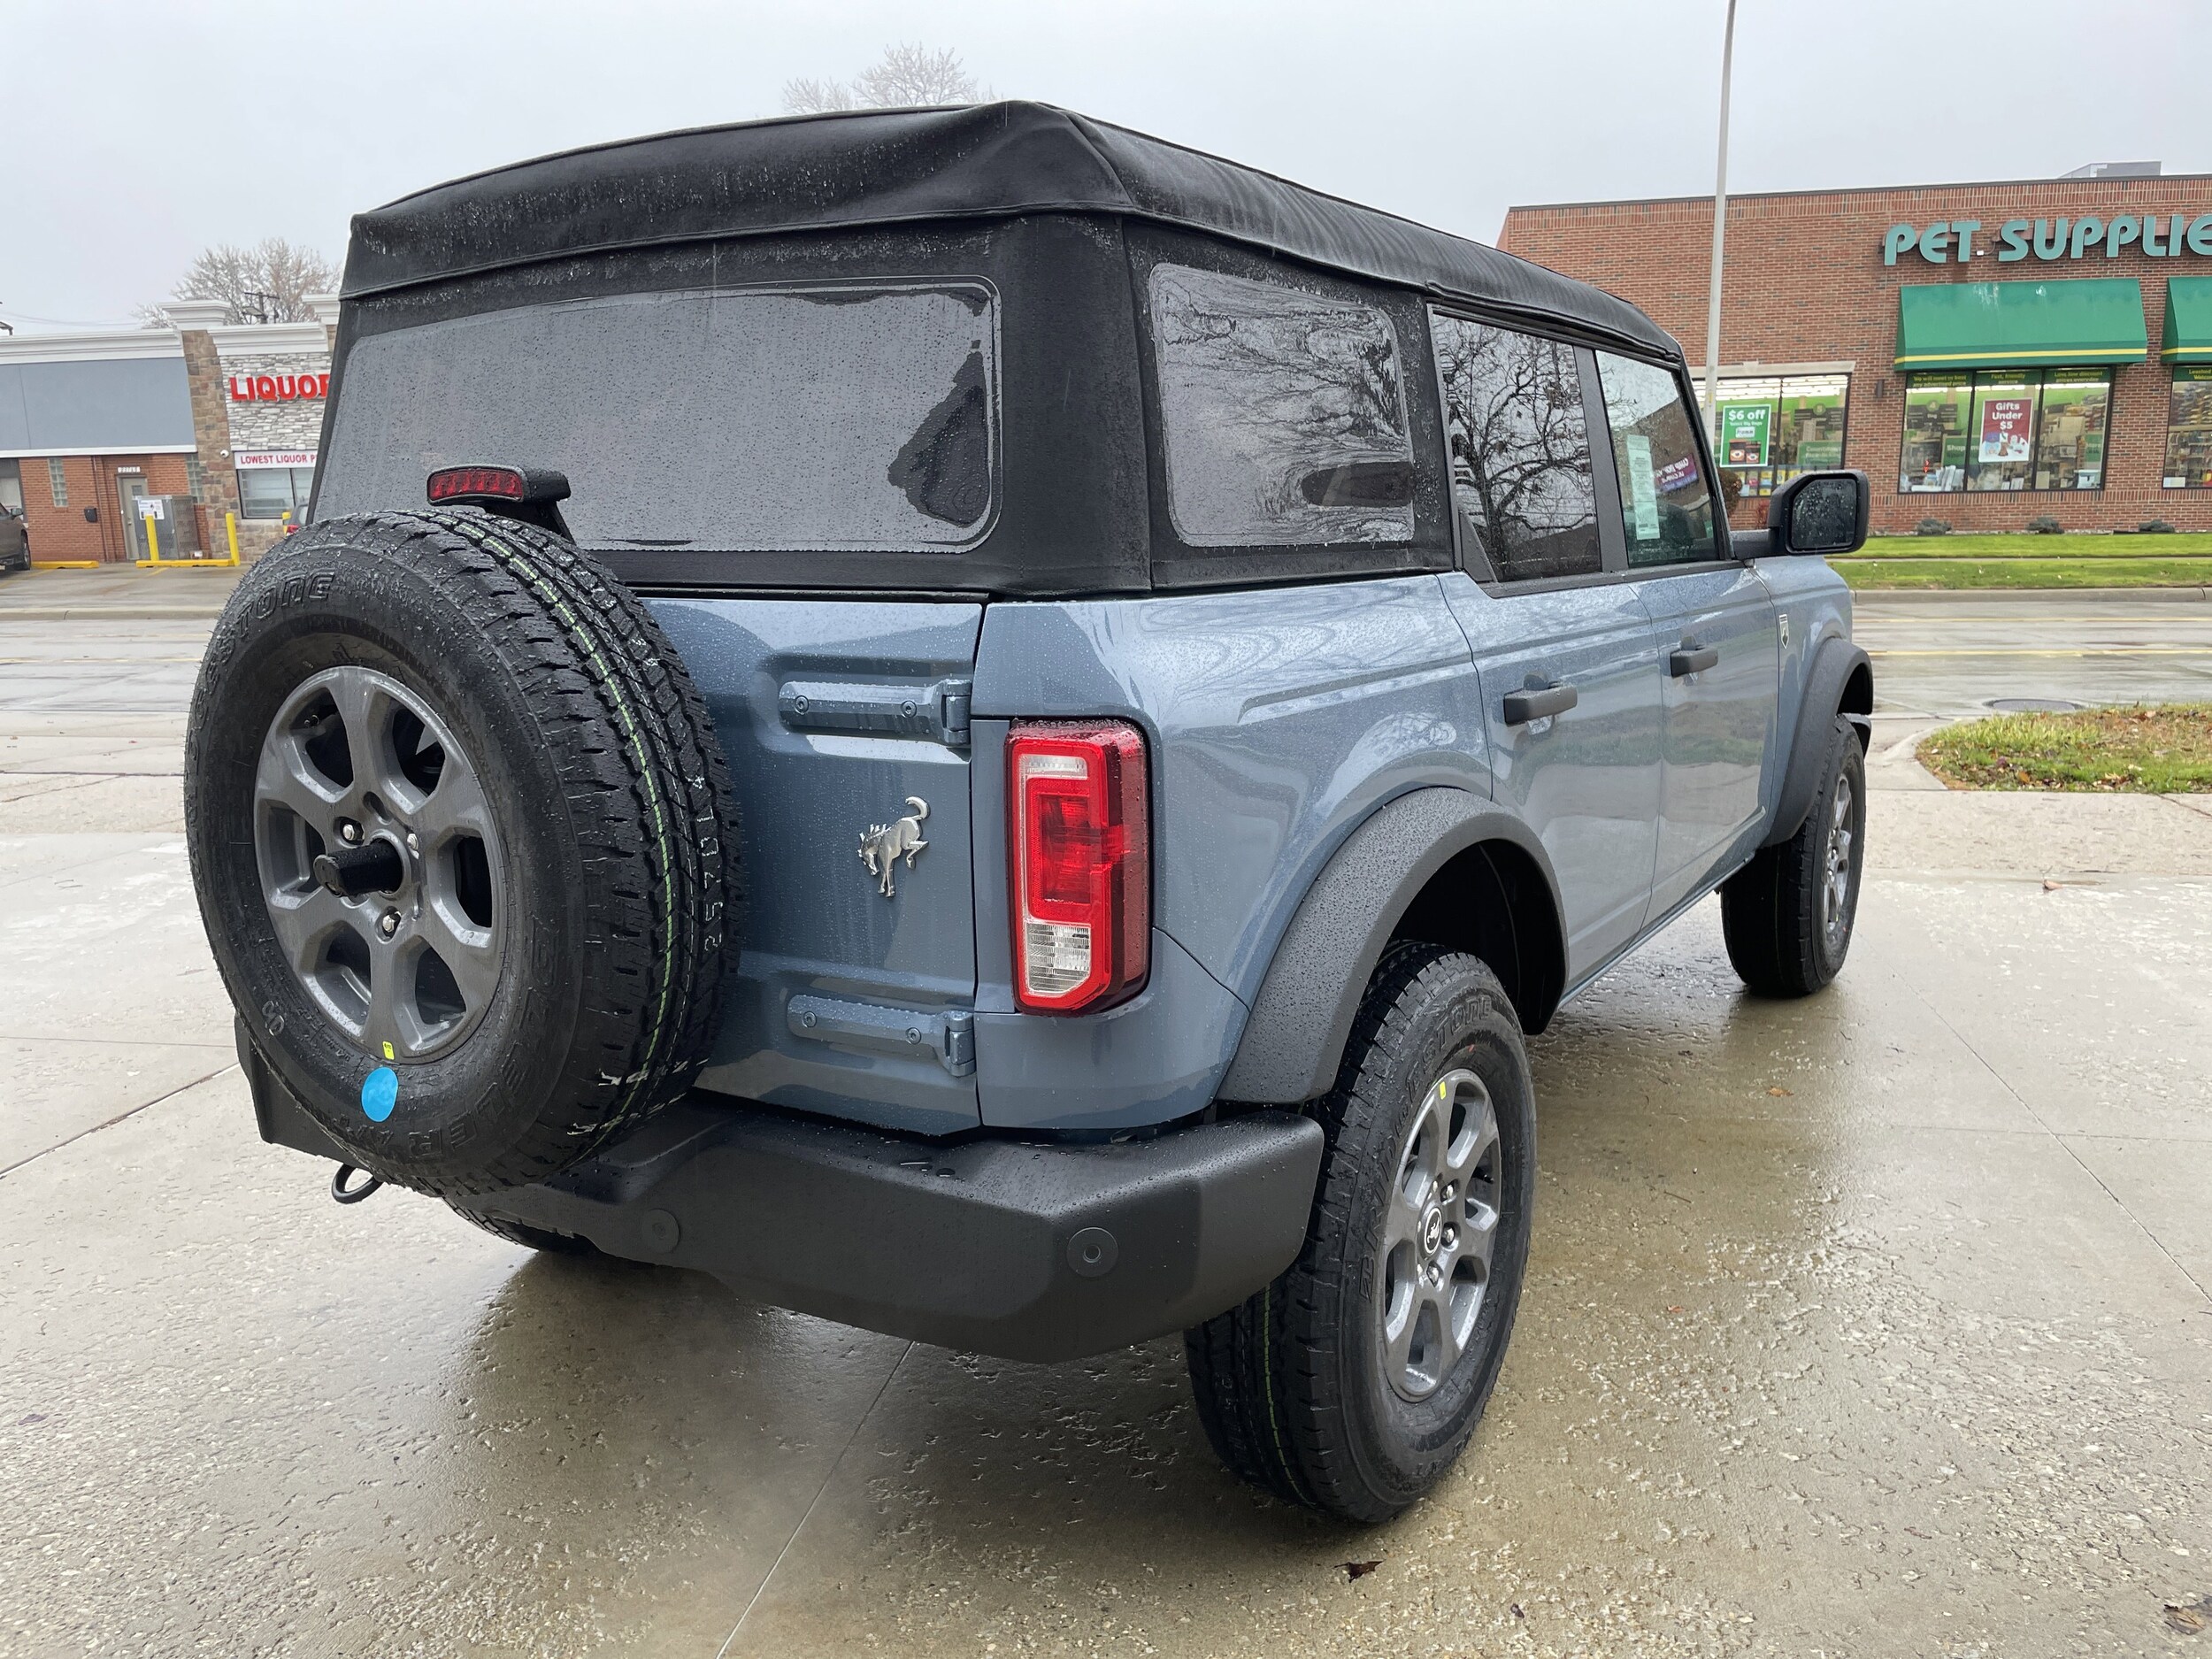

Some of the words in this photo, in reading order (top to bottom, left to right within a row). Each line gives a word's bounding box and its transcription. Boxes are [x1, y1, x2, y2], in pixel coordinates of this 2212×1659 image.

[1884, 219, 1981, 266] PET
[1996, 402, 2020, 411] Gifts
[1728, 410, 1744, 421] $6
[1747, 410, 1766, 420] off
[1992, 411, 2023, 420] Under
[2000, 419, 2013, 430] $5
[241, 455, 273, 465] LOWEST
[276, 454, 307, 463] LIQUOR
